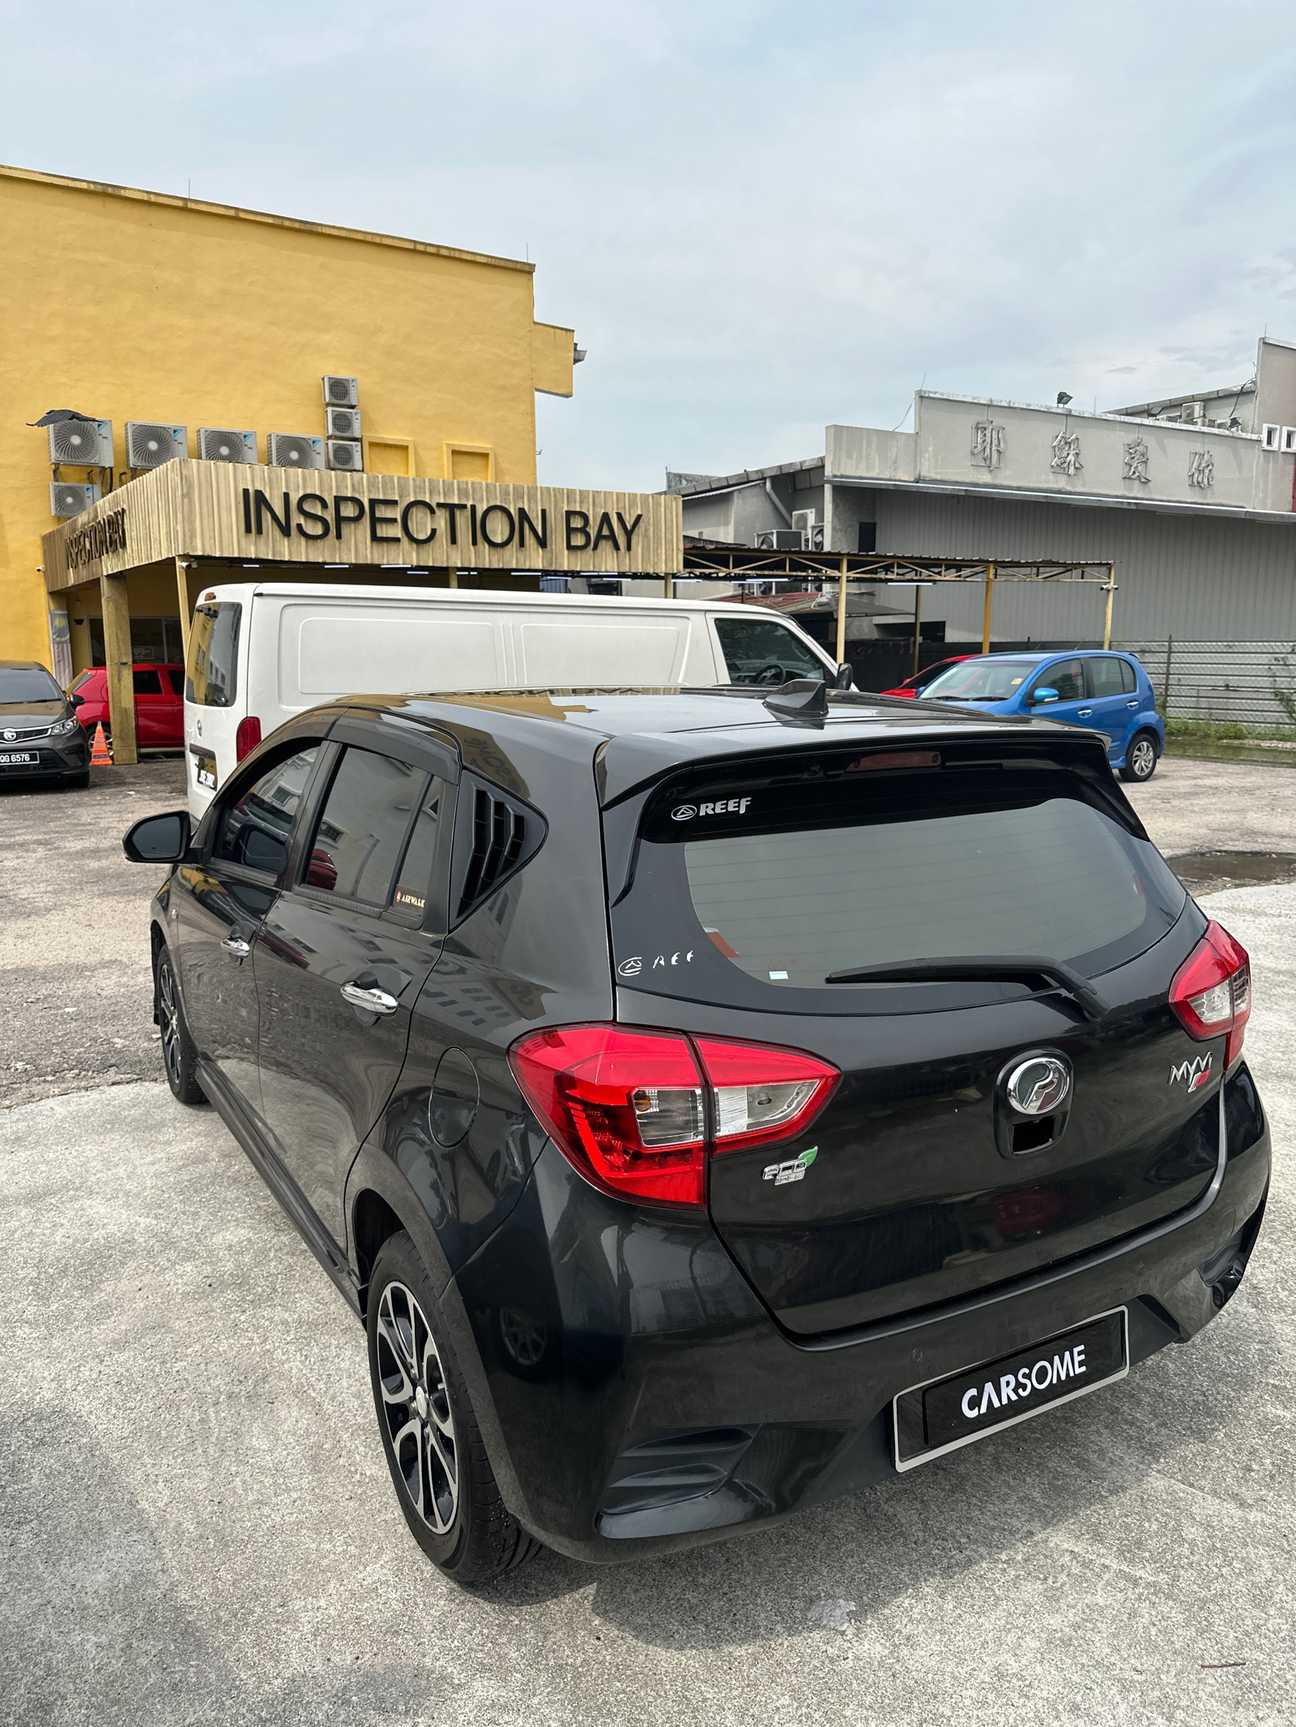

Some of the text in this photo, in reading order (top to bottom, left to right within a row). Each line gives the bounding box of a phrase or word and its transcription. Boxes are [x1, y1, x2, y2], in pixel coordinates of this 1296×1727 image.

[242, 487, 643, 552] INSPECTION BAY
[699, 797, 752, 816] REEF
[961, 1344, 1087, 1419] CARSOME
